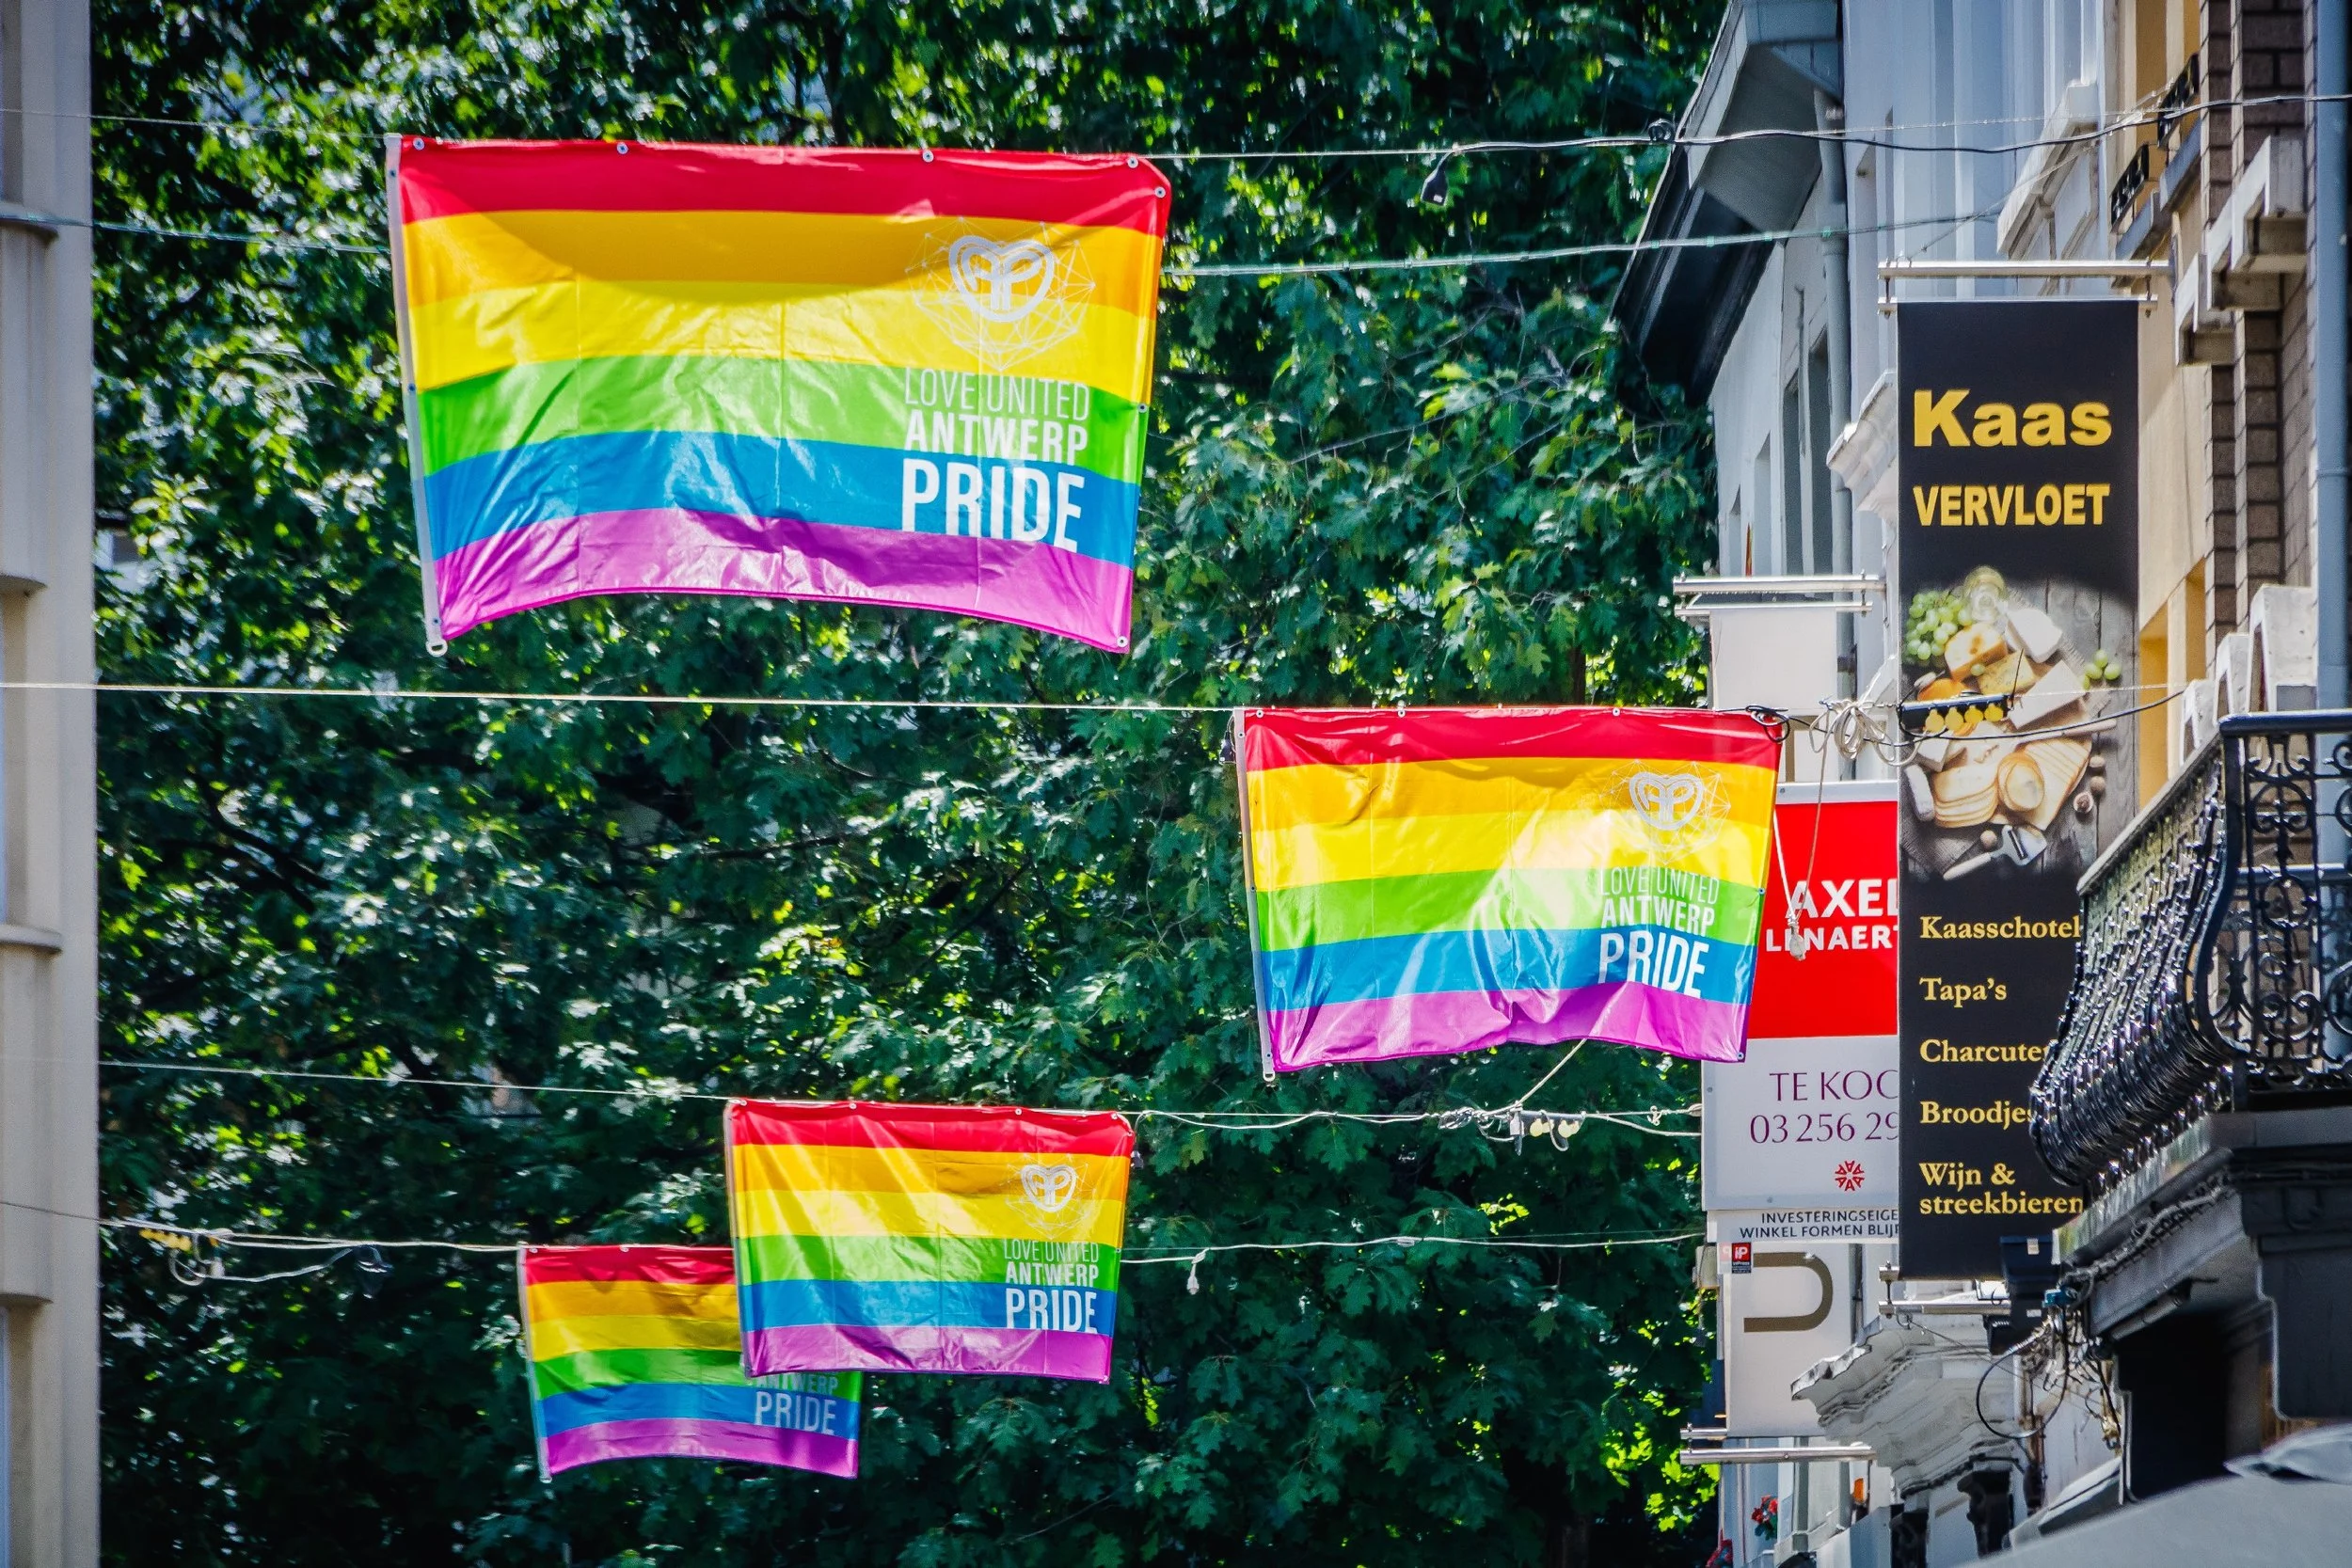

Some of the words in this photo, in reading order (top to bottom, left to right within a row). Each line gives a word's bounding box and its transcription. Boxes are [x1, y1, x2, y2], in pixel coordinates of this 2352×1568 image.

[904, 368, 977, 411] LOVE
[987, 375, 1090, 422] UNITED
[1914, 388, 2112, 447] Kaas
[904, 410, 1088, 466] ANTWERP
[901, 458, 1086, 554] PRIDE
[1913, 483, 2111, 527] VERVLOET
[1599, 866, 1649, 896] LOVE
[1657, 865, 1720, 906] UNITED
[1784, 879, 1898, 919] AXEL
[1600, 895, 1715, 938] ANTWERP
[1919, 915, 2082, 940] Kaasschotel
[1597, 929, 1709, 999] PRIDE
[1919, 977, 2008, 1008] Tapa's
[1769, 1072, 1808, 1101] TE
[1750, 1114, 1788, 1144] 03
[1796, 1113, 1855, 1143] 256
[1919, 1163, 1982, 1193] Wijn
[1991, 1164, 2015, 1186] &
[1761, 1210, 1899, 1224] INVESTERINGSEIGE
[1919, 1192, 2084, 1215] streekbieren
[1004, 1239, 1040, 1262] LOVE
[1045, 1242, 1100, 1263] UNITED
[1740, 1227, 1797, 1239] WINKEL
[1802, 1225, 1863, 1237] FORMEN
[1005, 1260, 1099, 1288] ANTWERP
[1005, 1288, 1098, 1335] PRIDE
[755, 1391, 836, 1435] PRIDE
